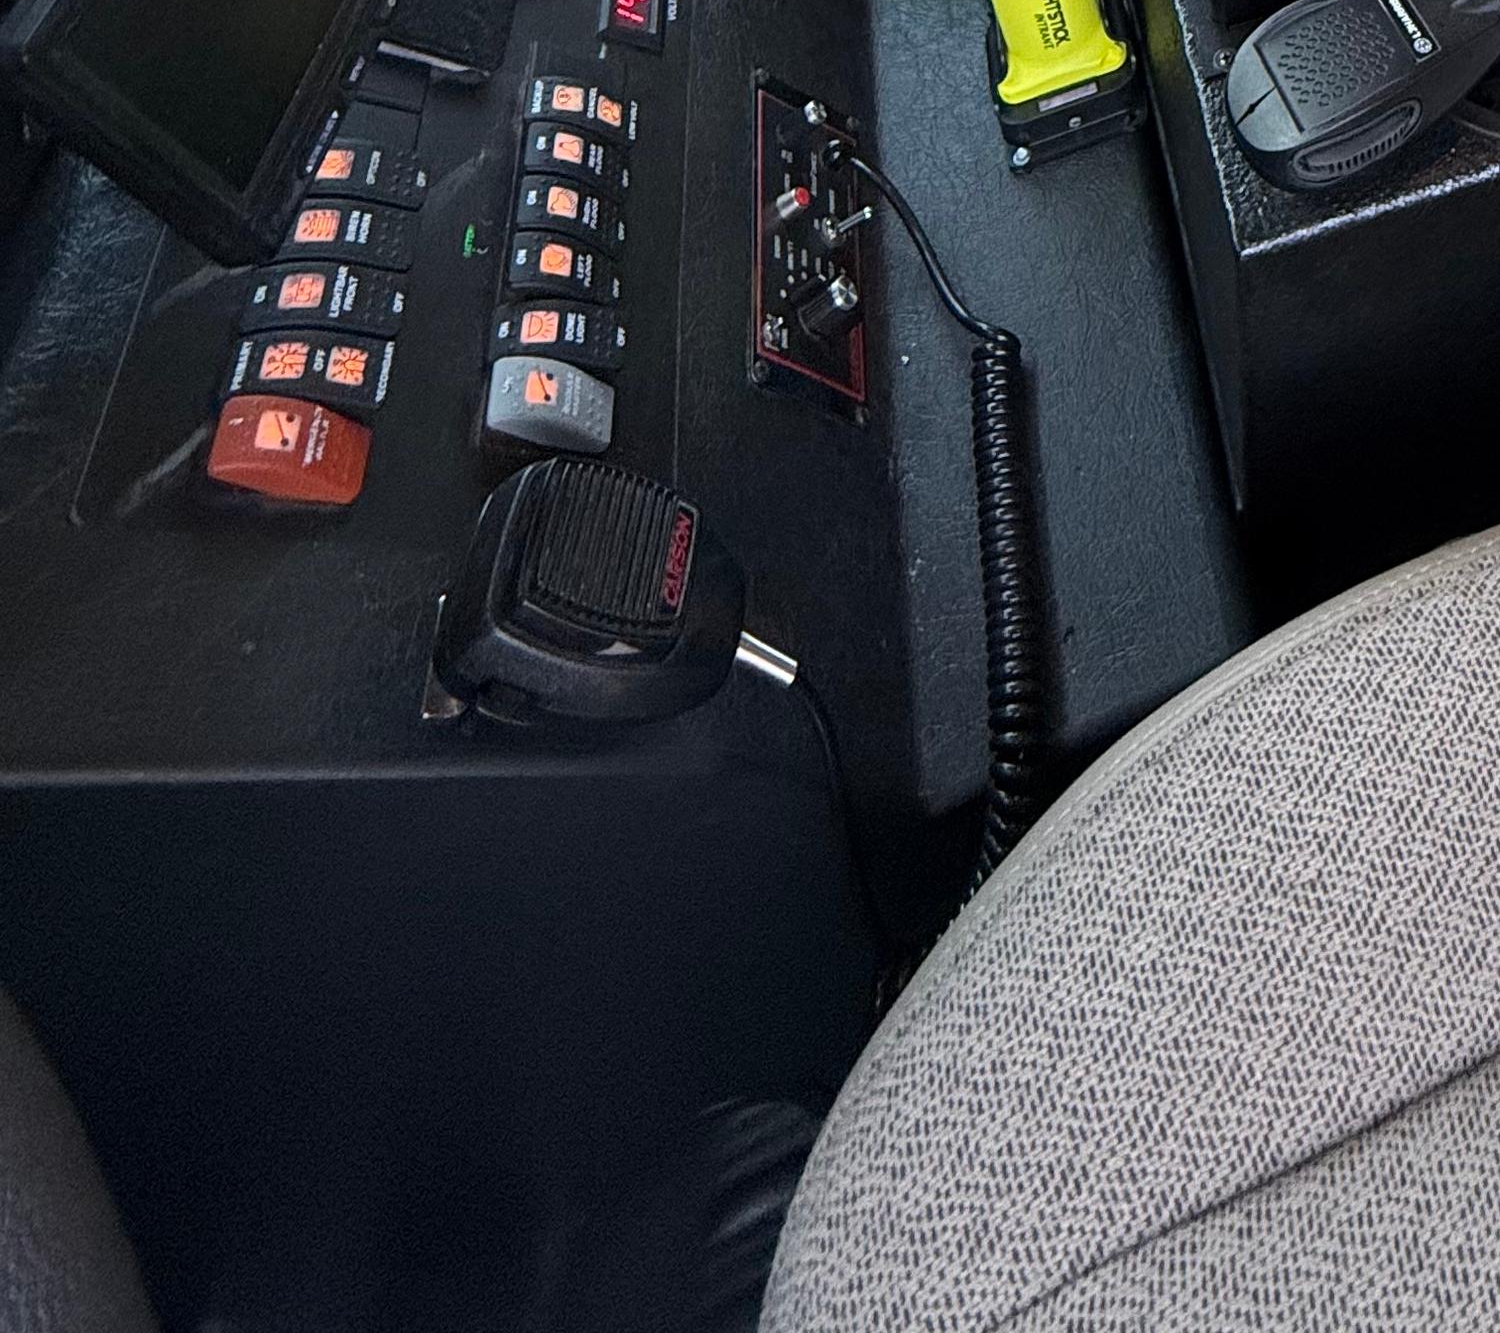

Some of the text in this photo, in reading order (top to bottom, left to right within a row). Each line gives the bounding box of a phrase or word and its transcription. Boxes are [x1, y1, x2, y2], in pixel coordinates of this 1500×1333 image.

[1034, 14, 1055, 49] INTRANT
[531, 80, 544, 114] BACKUP
[586, 87, 598, 119] CANCEL
[536, 136, 546, 150] ON
[594, 145, 604, 175] FLOOD
[527, 190, 537, 205] ON
[345, 210, 361, 243] SIREN
[357, 213, 373, 244] HORN
[589, 198, 599, 230] FLOOD
[516, 249, 528, 265] ON
[576, 254, 586, 279] LEFT
[583, 254, 593, 287] FLOOD
[253, 285, 268, 304] ON
[328, 265, 349, 319] LIGHTBAR
[342, 276, 359, 312] FRONT
[392, 291, 405, 314] OFF
[498, 321, 511, 339] ON
[565, 312, 577, 342] DOME
[576, 313, 587, 345] LIGHT
[616, 326, 626, 347] OFF
[229, 340, 253, 392] PRIMARY
[312, 348, 326, 372] OFF
[663, 511, 692, 607] CARSON
